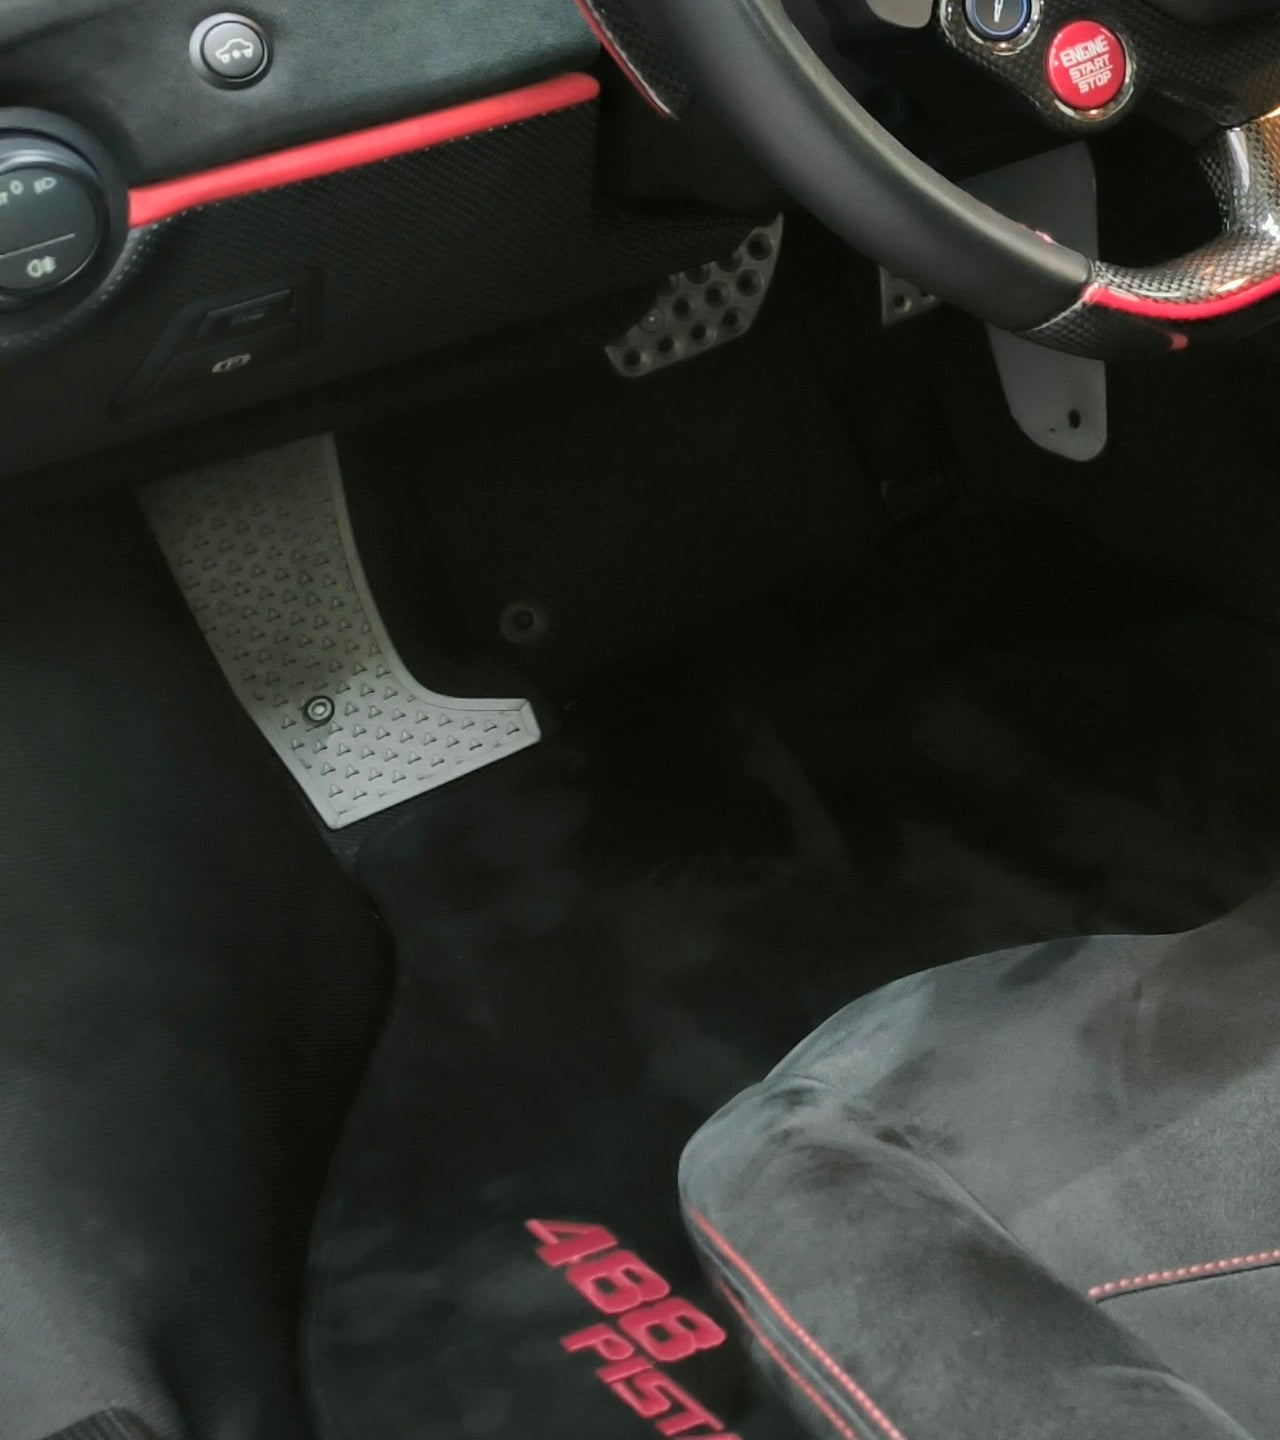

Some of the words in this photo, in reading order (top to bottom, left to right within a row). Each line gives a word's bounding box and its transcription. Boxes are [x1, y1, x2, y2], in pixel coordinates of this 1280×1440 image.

[1059, 34, 1110, 68] ENGINE
[1068, 53, 1110, 85] START
[1077, 70, 1112, 94] STOP
[524, 1219, 727, 1363] 488
[560, 1323, 742, 1440] PIST
